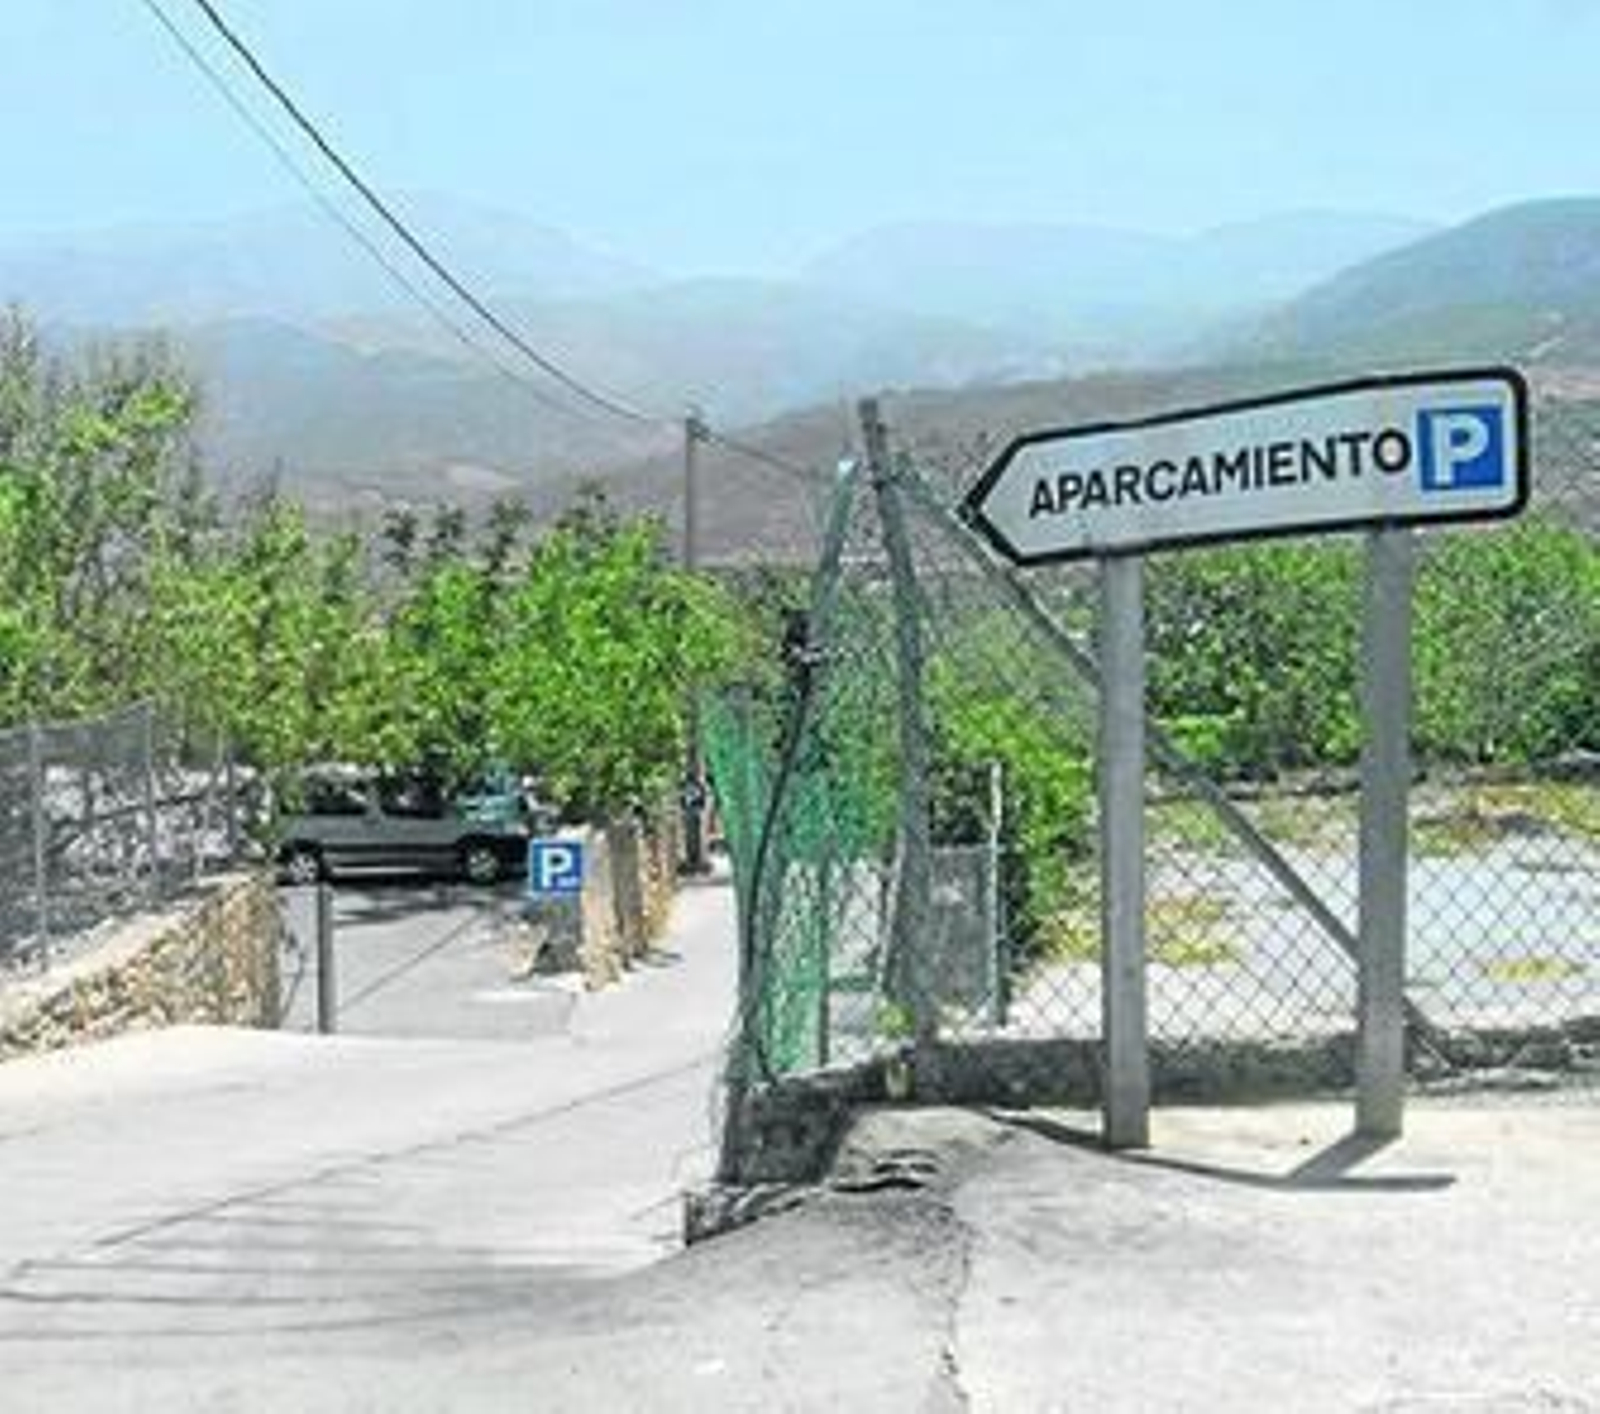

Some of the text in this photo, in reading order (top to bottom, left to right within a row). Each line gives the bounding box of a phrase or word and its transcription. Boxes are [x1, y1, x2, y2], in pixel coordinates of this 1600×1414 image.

[1028, 412, 1490, 519] APARCAMIENTO P
[541, 847, 573, 888] P
